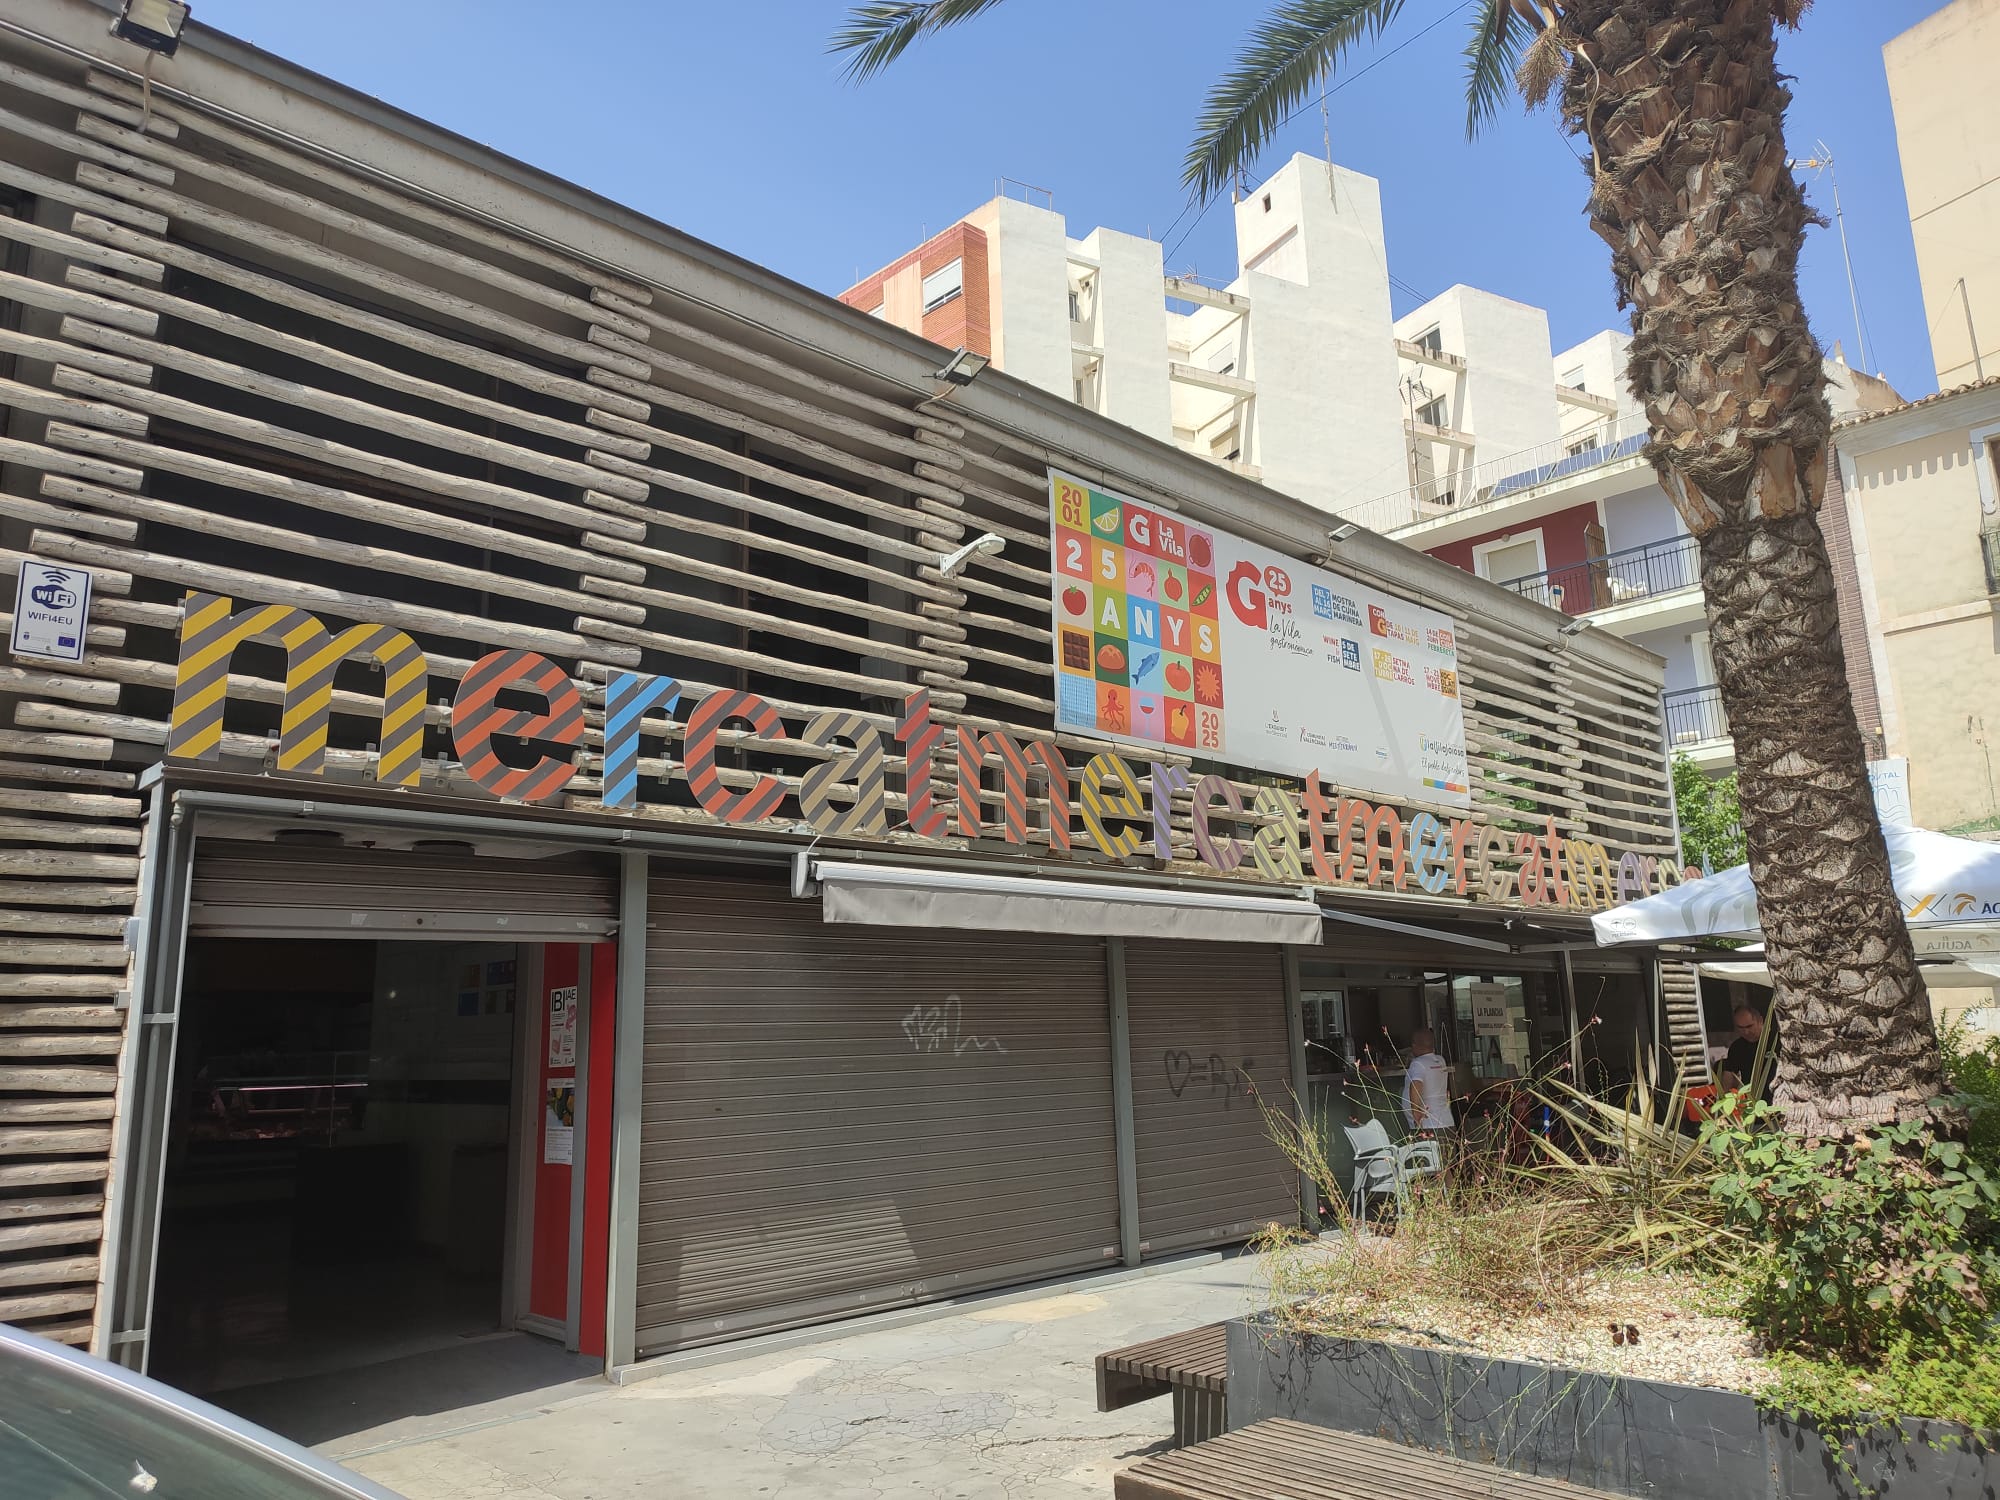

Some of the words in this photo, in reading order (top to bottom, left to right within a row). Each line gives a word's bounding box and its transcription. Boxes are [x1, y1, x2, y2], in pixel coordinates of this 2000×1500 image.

[1061, 485, 1083, 508] 20
[1062, 503, 1083, 527] 01
[1129, 513, 1151, 547] G
[1158, 520, 1174, 540] La
[1159, 535, 1185, 558] Vila
[1268, 569, 1287, 592] 25
[1225, 560, 1268, 631] G
[1332, 594, 1356, 608] MOSTRA
[1268, 597, 1292, 615] anys
[1333, 603, 1341, 612] DE
[1341, 605, 1360, 618] CUINA
[28, 611, 73, 626] WIFI4EU
[1269, 613, 1281, 634] La
[1281, 618, 1301, 640] Vila
[1333, 611, 1363, 627] MARINERA
[1387, 629, 1405, 641] TAPAS
[1327, 654, 1341, 665] FISH
[1201, 711, 1219, 730] 20
[1202, 728, 1220, 748] 25
[1476, 1007, 1483, 1017] LA
